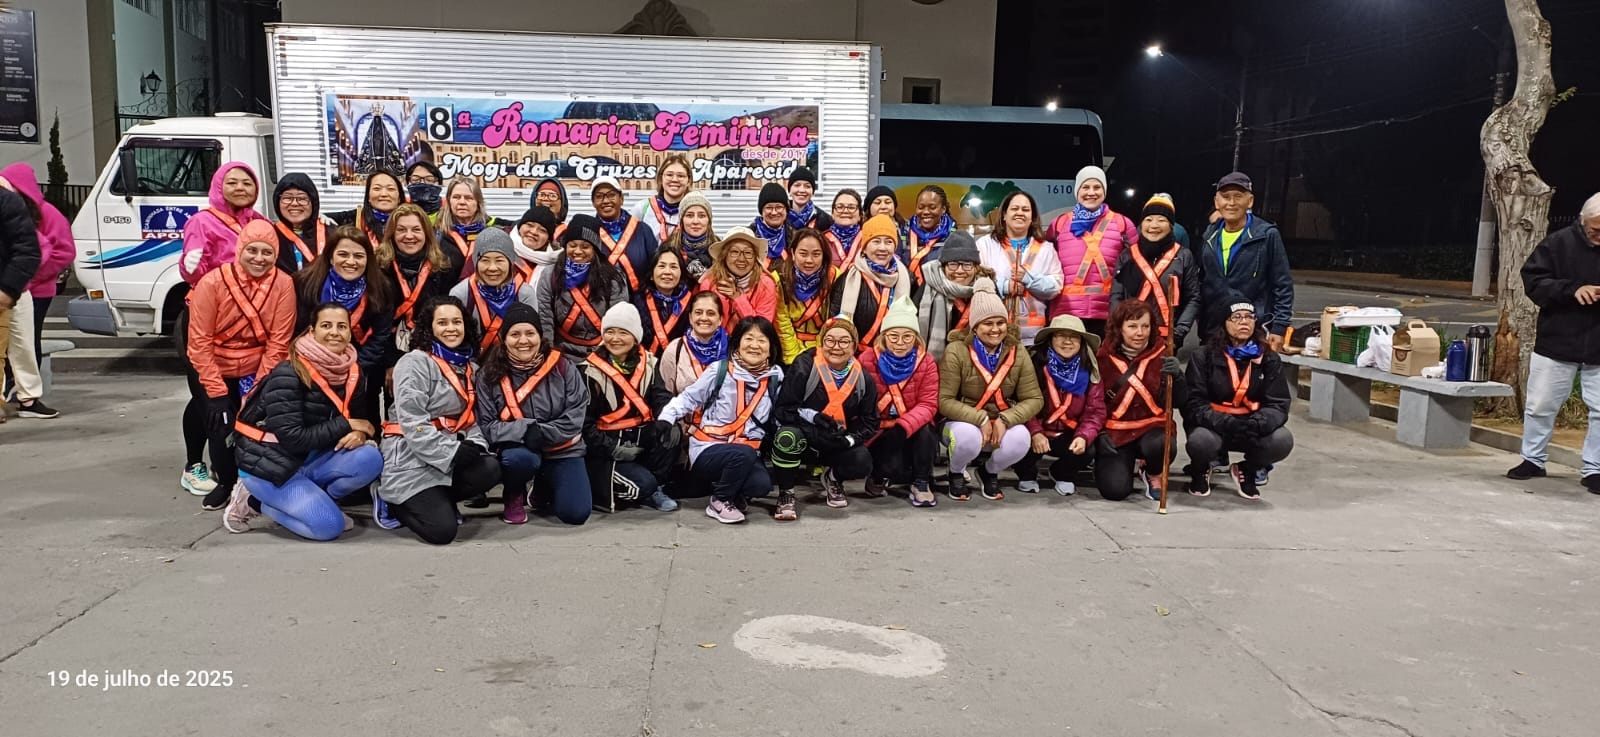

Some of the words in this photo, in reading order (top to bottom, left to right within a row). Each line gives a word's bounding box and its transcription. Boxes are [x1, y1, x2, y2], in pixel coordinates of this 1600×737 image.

[482, 101, 639, 149] Romaria
[650, 110, 809, 151] Feminina
[439, 153, 508, 182] Mogi
[515, 157, 558, 178] das
[567, 155, 657, 180] Cruzes
[741, 149, 777, 160] desde
[780, 150, 808, 161] 2017
[692, 158, 810, 184] Aparecid
[1047, 184, 1073, 194] 1610
